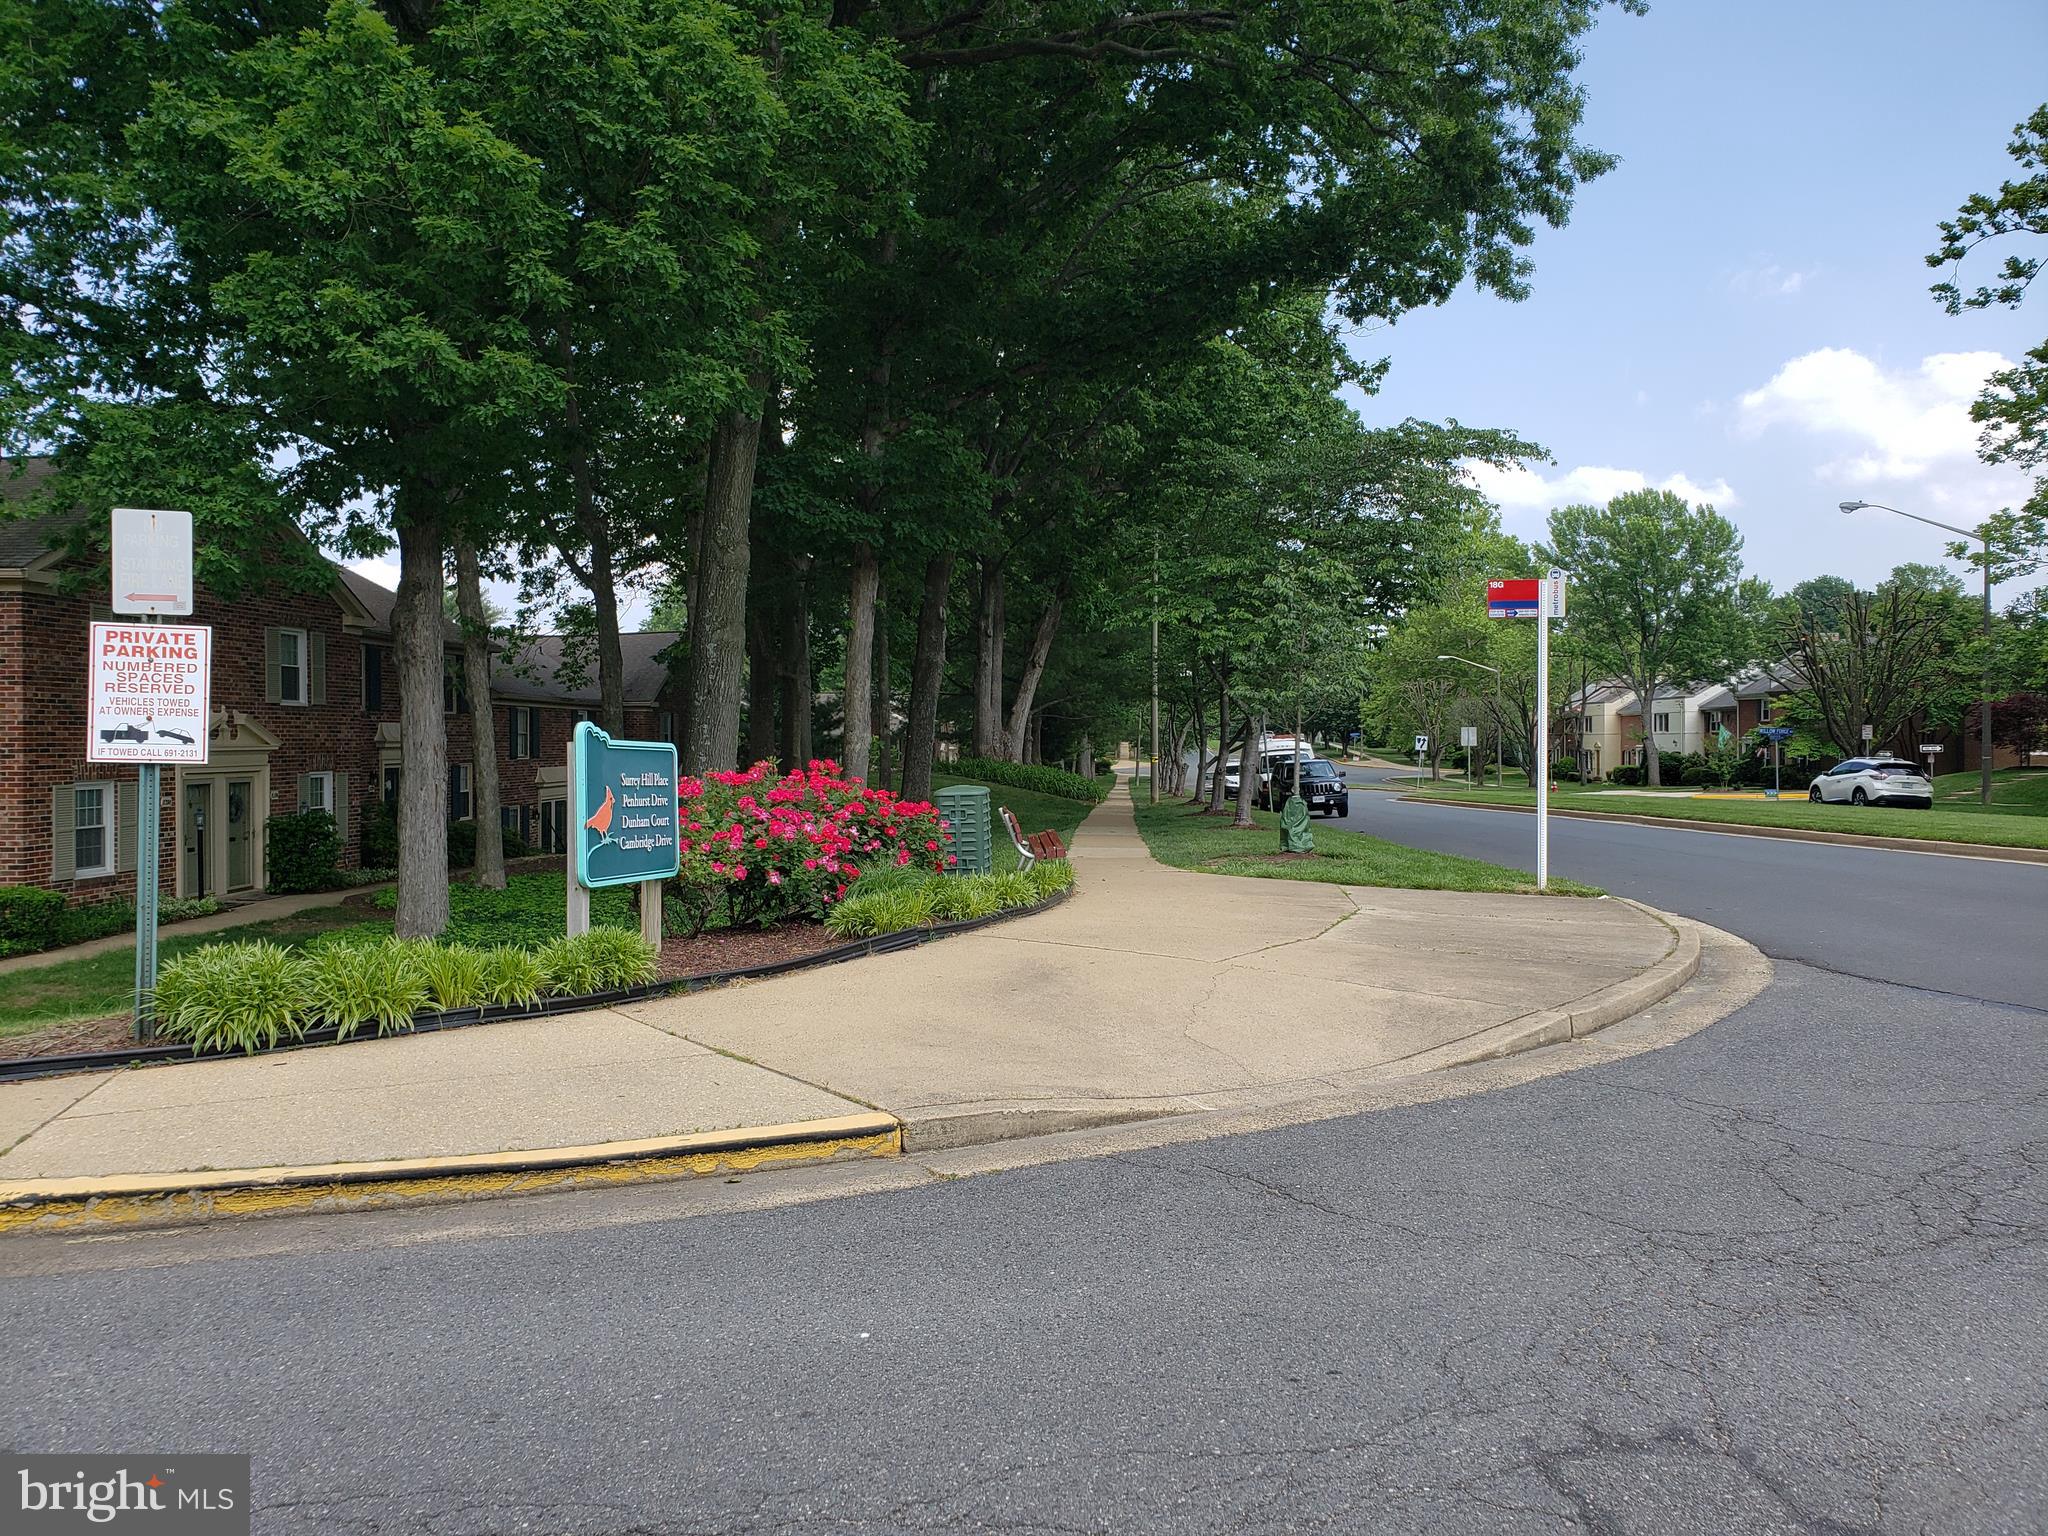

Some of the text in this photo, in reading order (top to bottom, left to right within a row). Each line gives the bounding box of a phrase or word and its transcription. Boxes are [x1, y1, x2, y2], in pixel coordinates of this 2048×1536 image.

[122, 534, 180, 548] PARKING
[120, 558, 185, 573] STANDING
[1489, 581, 1504, 589] 18G
[105, 630, 196, 646] PRIVATE
[103, 644, 198, 660] PARKING
[103, 660, 198, 673] NUMBERED
[116, 672, 184, 684] SPACES
[105, 682, 195, 695] RESERVED
[109, 696, 190, 707] VEHICLES TOWED
[98, 706, 199, 717] AT OWNERS EXPENSE
[108, 748, 138, 756] TOWED
[140, 748, 162, 757] CALL
[164, 749, 198, 757] 691-2131
[621, 772, 669, 790] Surrey Hill Place
[622, 792, 668, 807] Penhurst Drive
[622, 813, 670, 828] Dunham Court
[620, 834, 672, 852] Cambridge Drive
